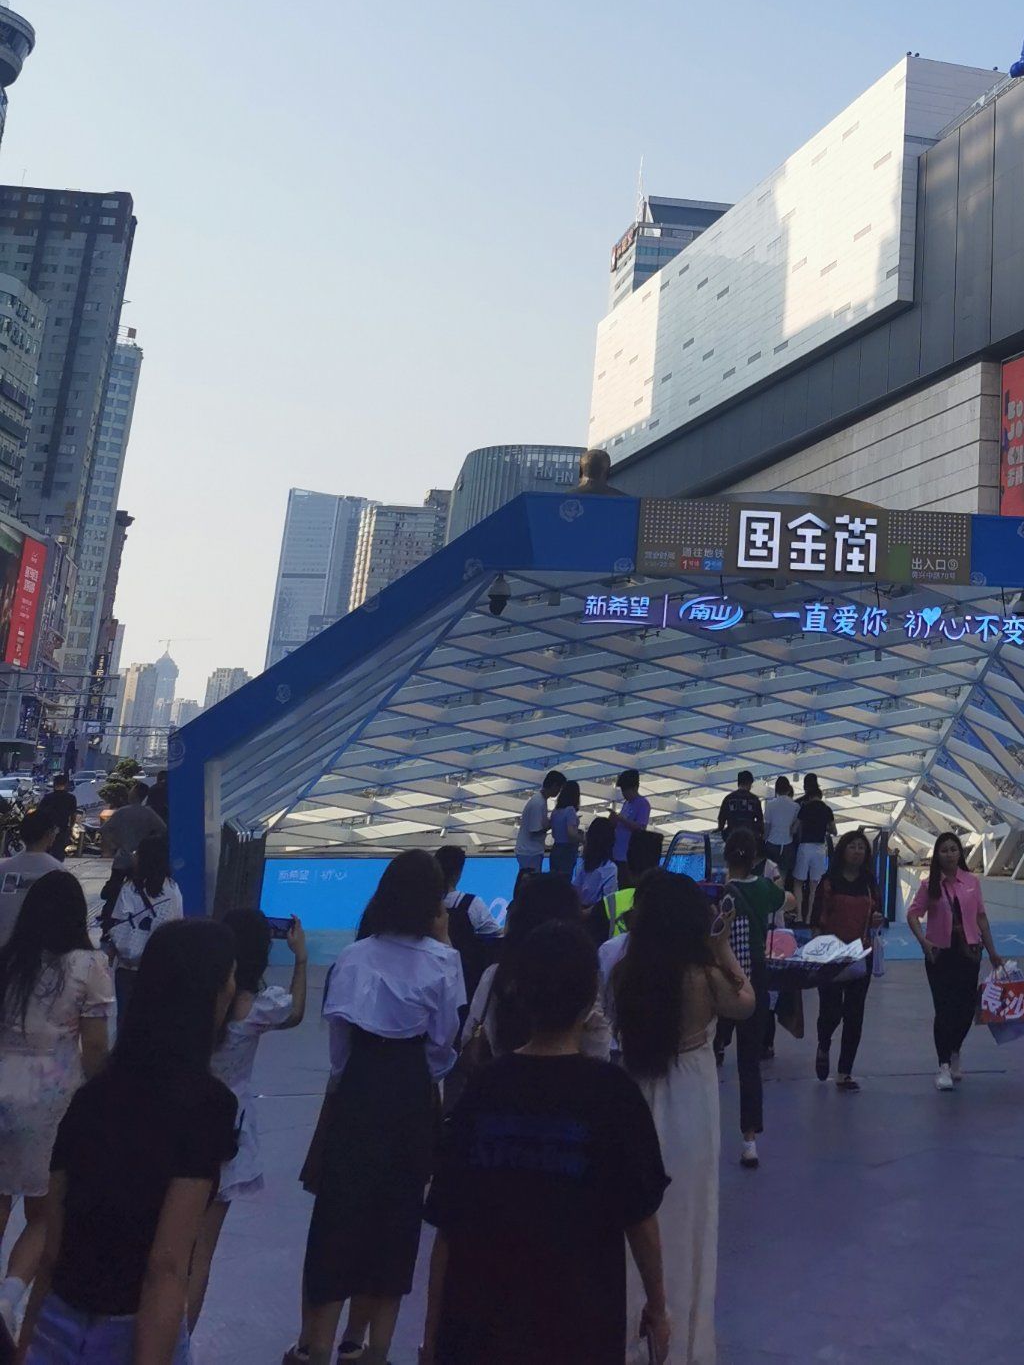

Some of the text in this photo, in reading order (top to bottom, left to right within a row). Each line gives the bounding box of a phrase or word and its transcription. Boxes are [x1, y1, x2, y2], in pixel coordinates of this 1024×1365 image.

[738, 510, 878, 573] 国金街
[585, 595, 650, 618] 新希望
[771, 605, 888, 636] 一直爱你
